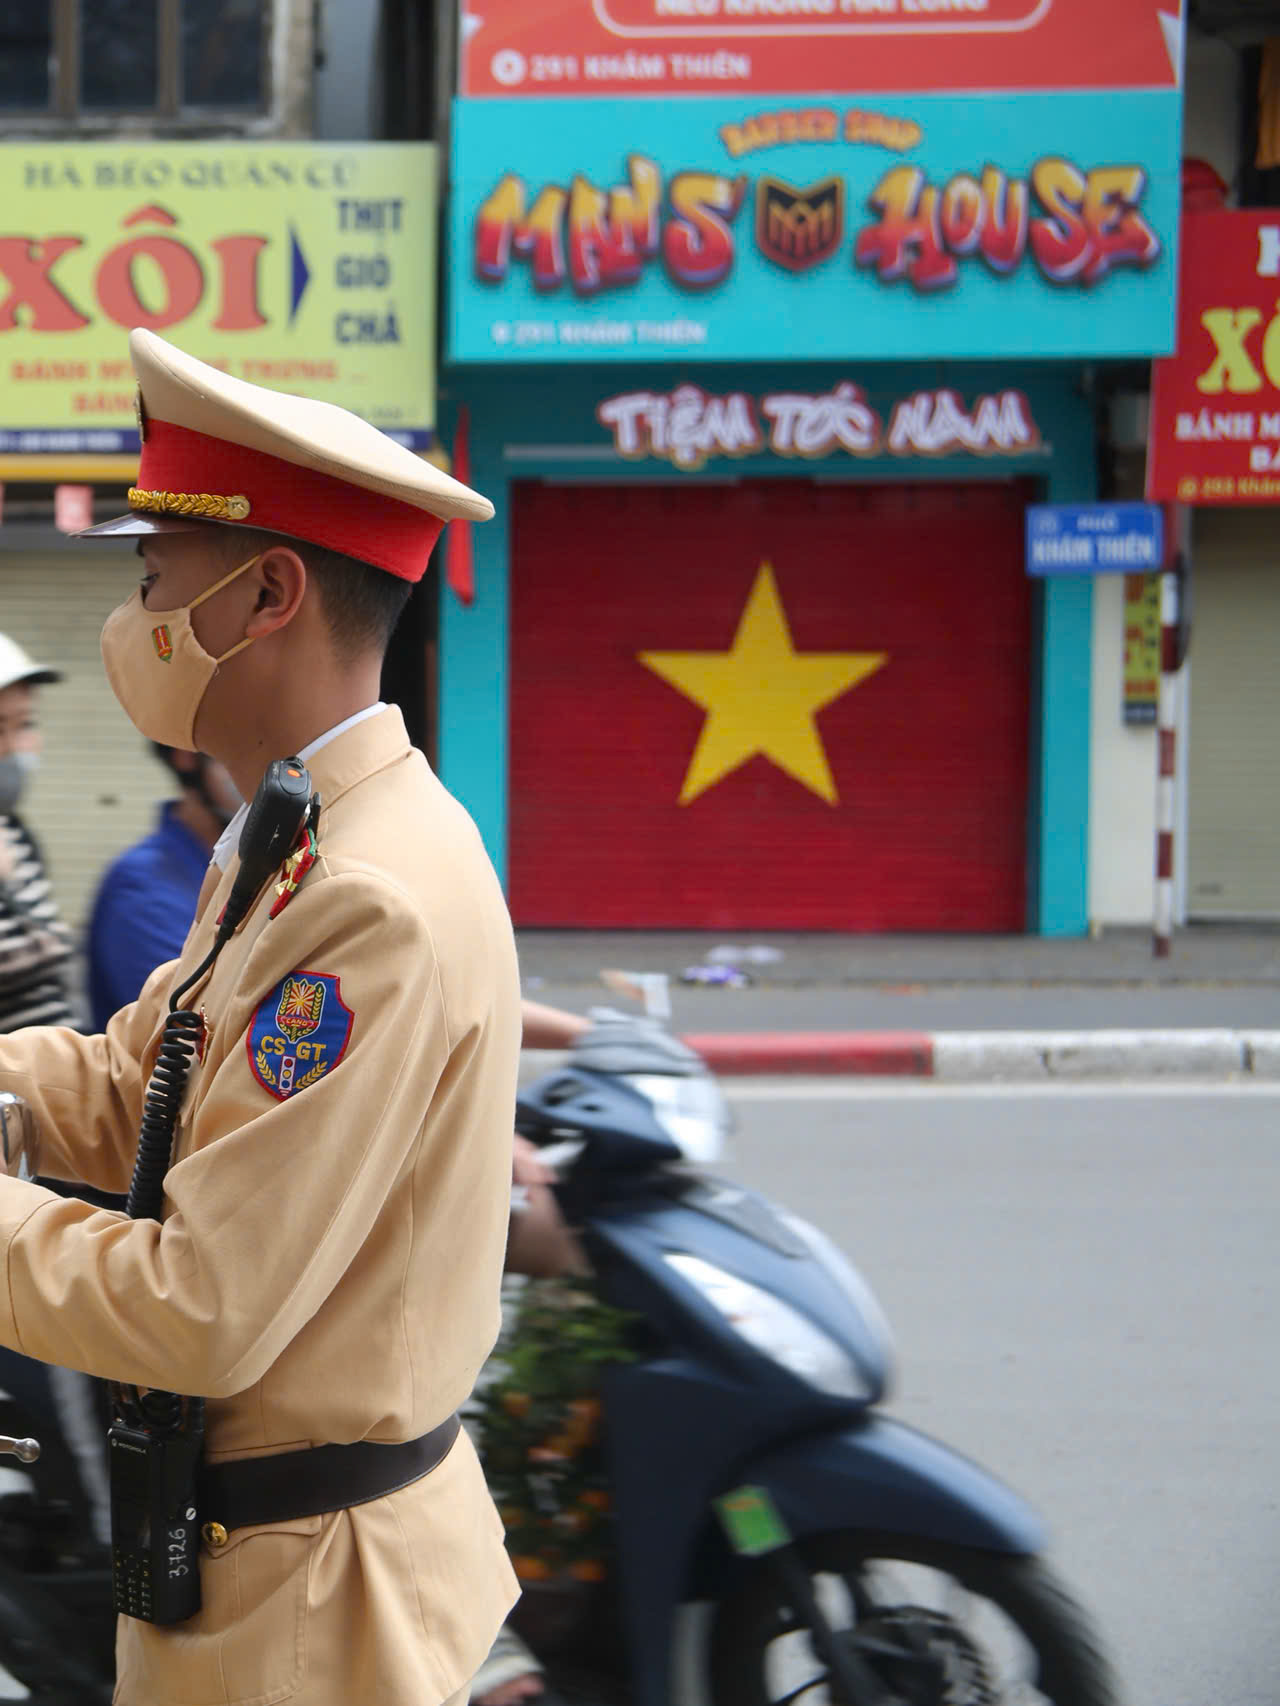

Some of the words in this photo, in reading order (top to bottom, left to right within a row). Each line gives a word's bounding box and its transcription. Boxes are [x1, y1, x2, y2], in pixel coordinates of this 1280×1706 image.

[854, 155, 1161, 294] HOUSE
[1195, 300, 1280, 394] X
[600, 384, 758, 466] TIỆM
[765, 383, 876, 452] TÓC
[888, 390, 1032, 452] NAM
[1175, 405, 1255, 441] BÁNH
